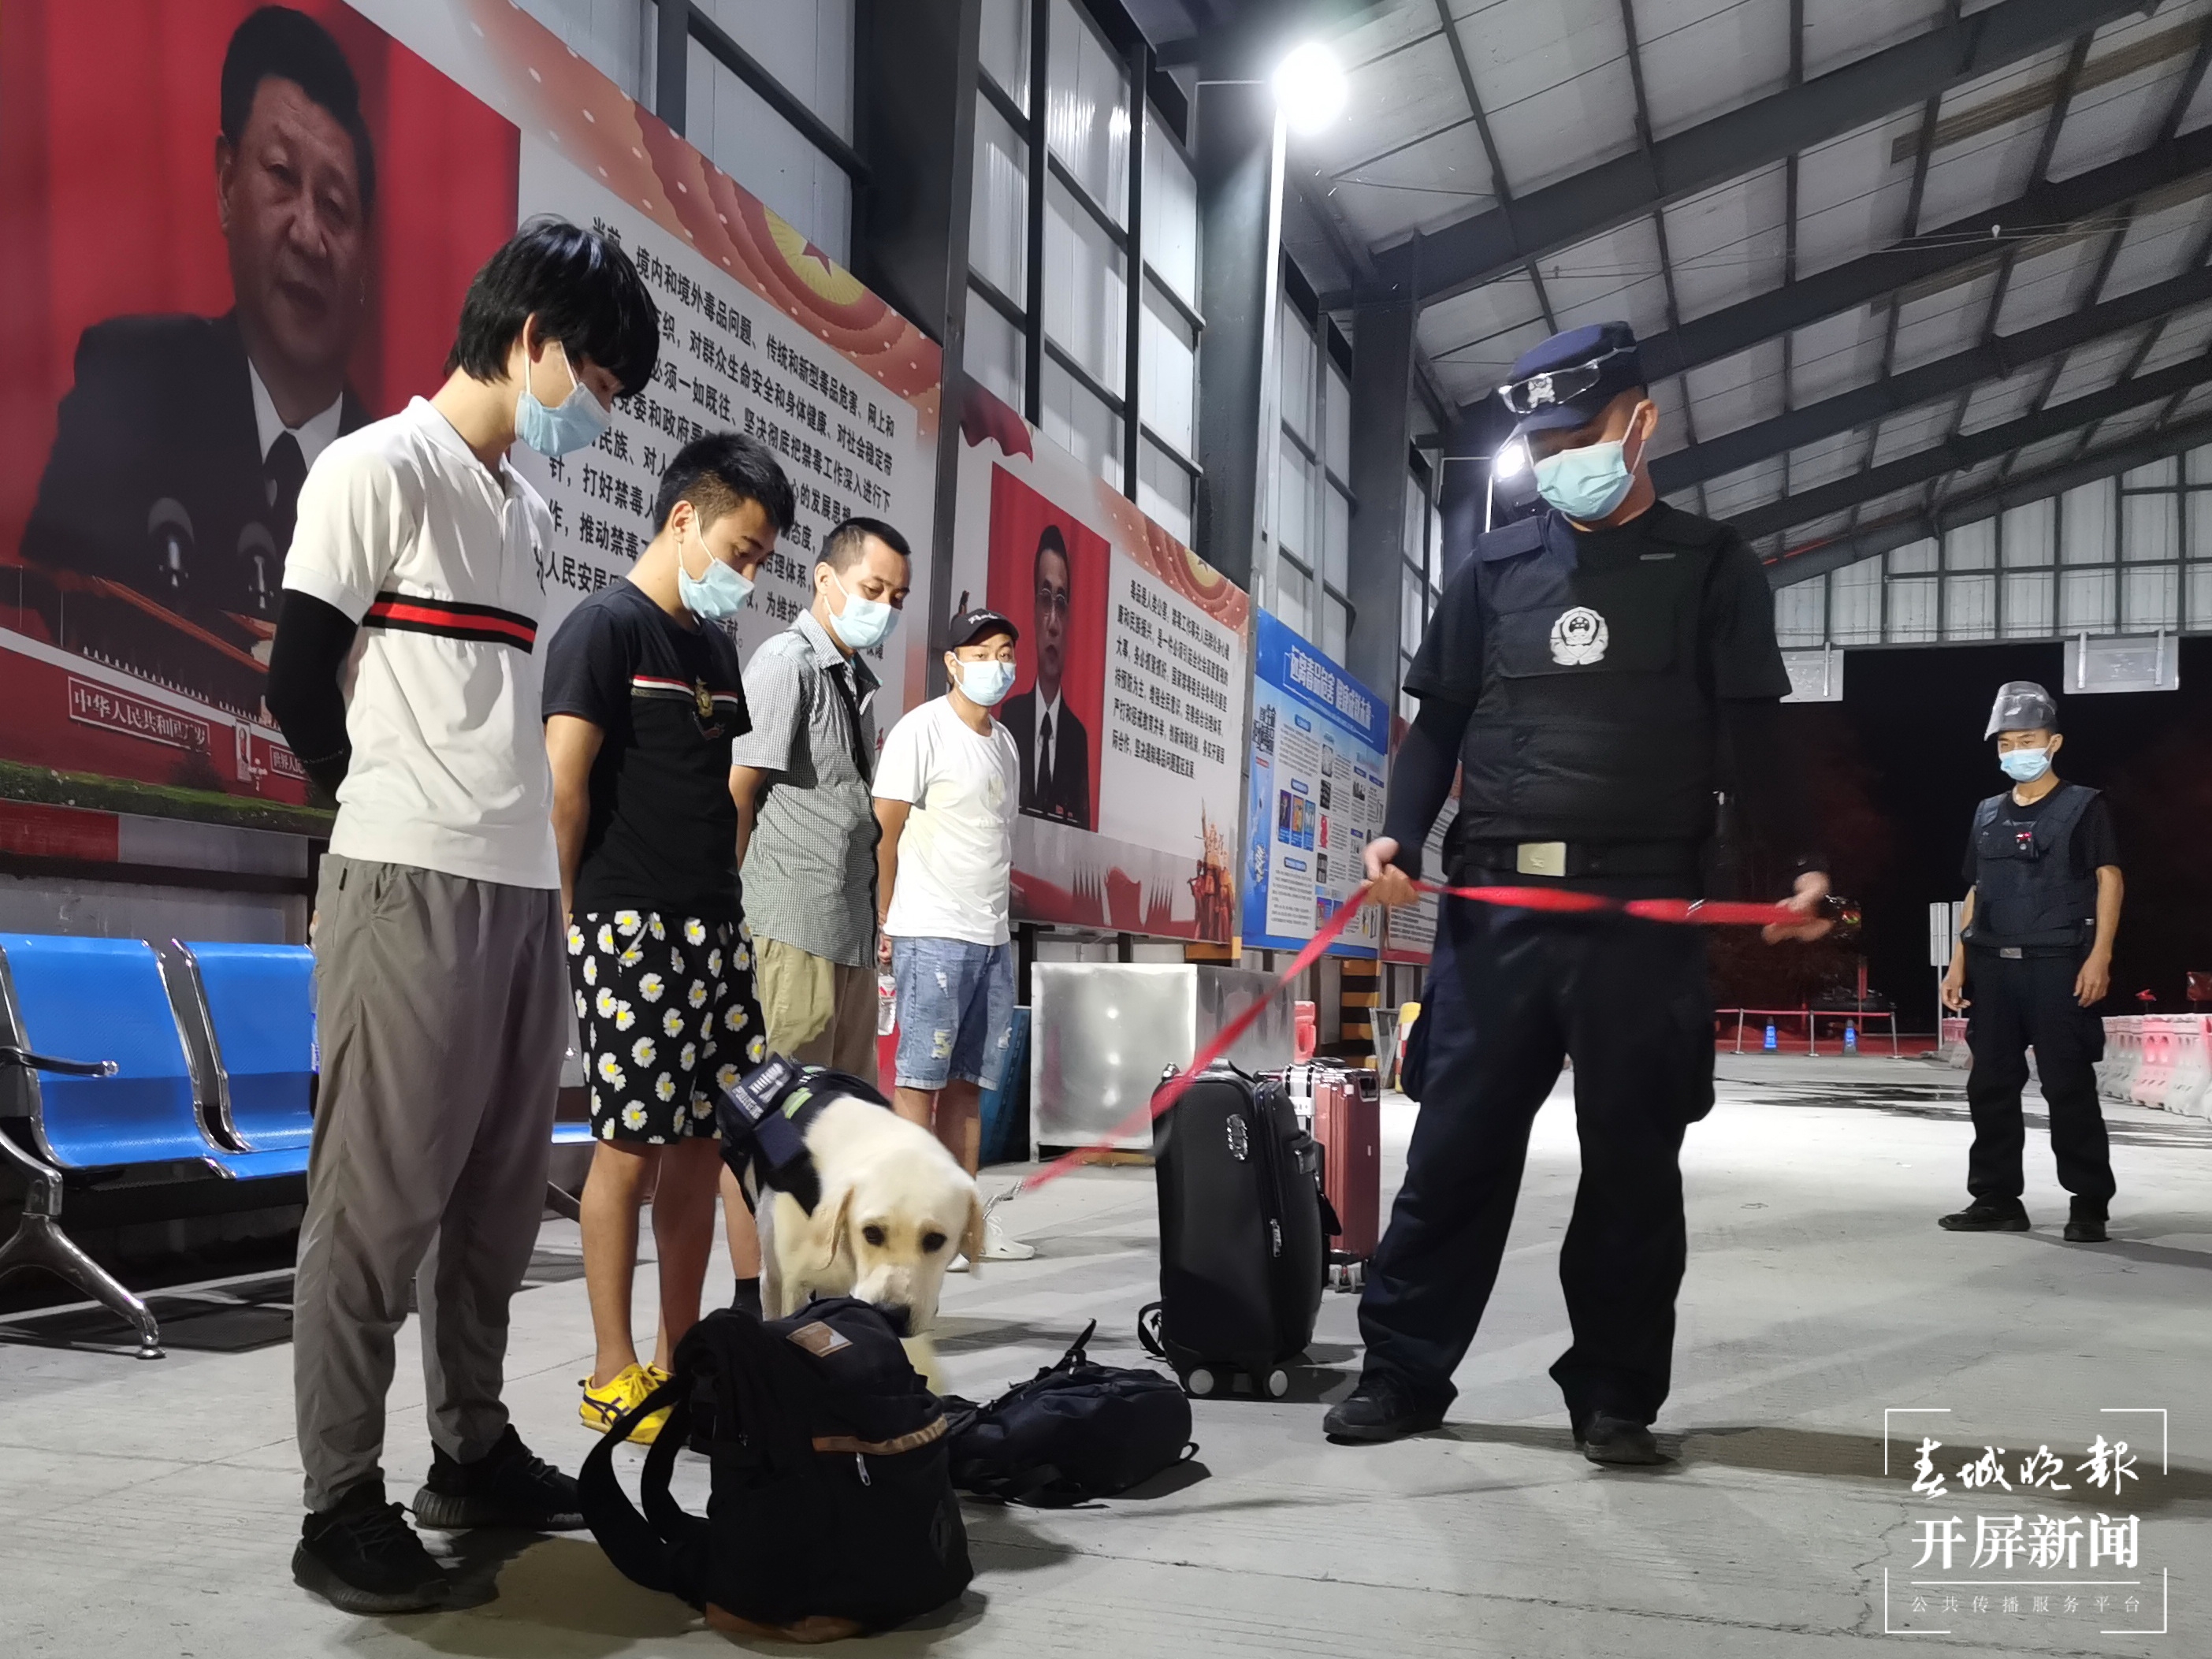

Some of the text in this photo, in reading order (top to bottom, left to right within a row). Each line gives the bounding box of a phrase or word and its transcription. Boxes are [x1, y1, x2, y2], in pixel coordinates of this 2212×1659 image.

[656, 308, 893, 476] 织，对群众生命安全和身体健康、对社会稳定带
[592, 426, 667, 478] 民族、对人
[548, 498, 650, 562] 作，推动禁毒
